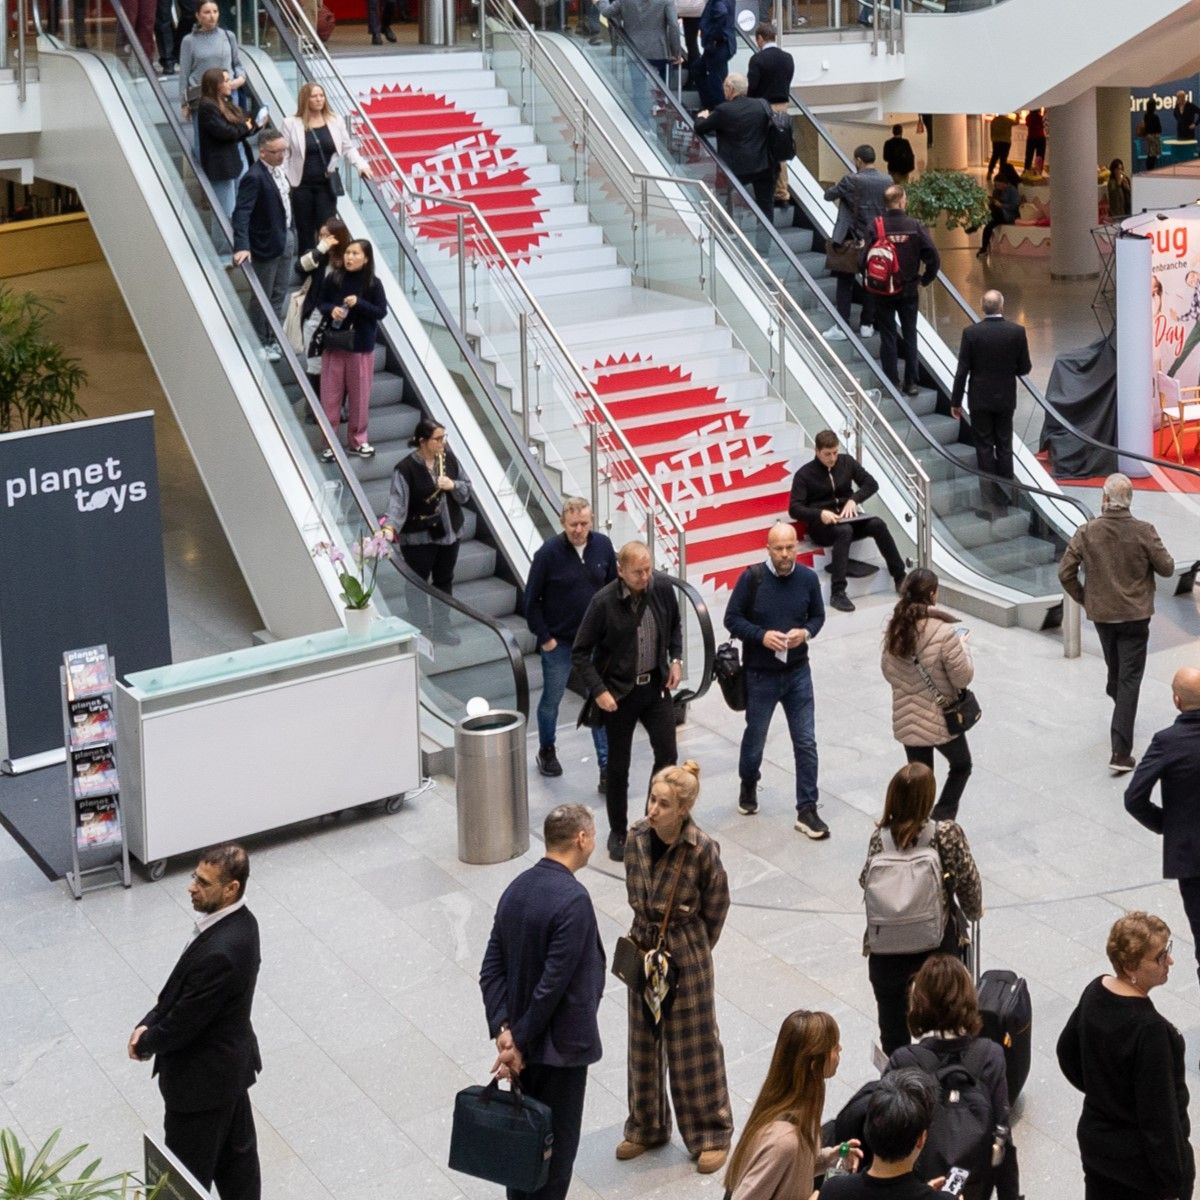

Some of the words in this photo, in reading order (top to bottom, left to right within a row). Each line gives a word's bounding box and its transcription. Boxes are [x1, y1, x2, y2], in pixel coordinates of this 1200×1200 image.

[1152, 260, 1188, 273] enbranche
[1154, 313, 1186, 357] Day
[6, 457, 122, 508] planet
[74, 481, 147, 513] toys
[68, 649, 98, 662] planet
[72, 699, 102, 712] planet
